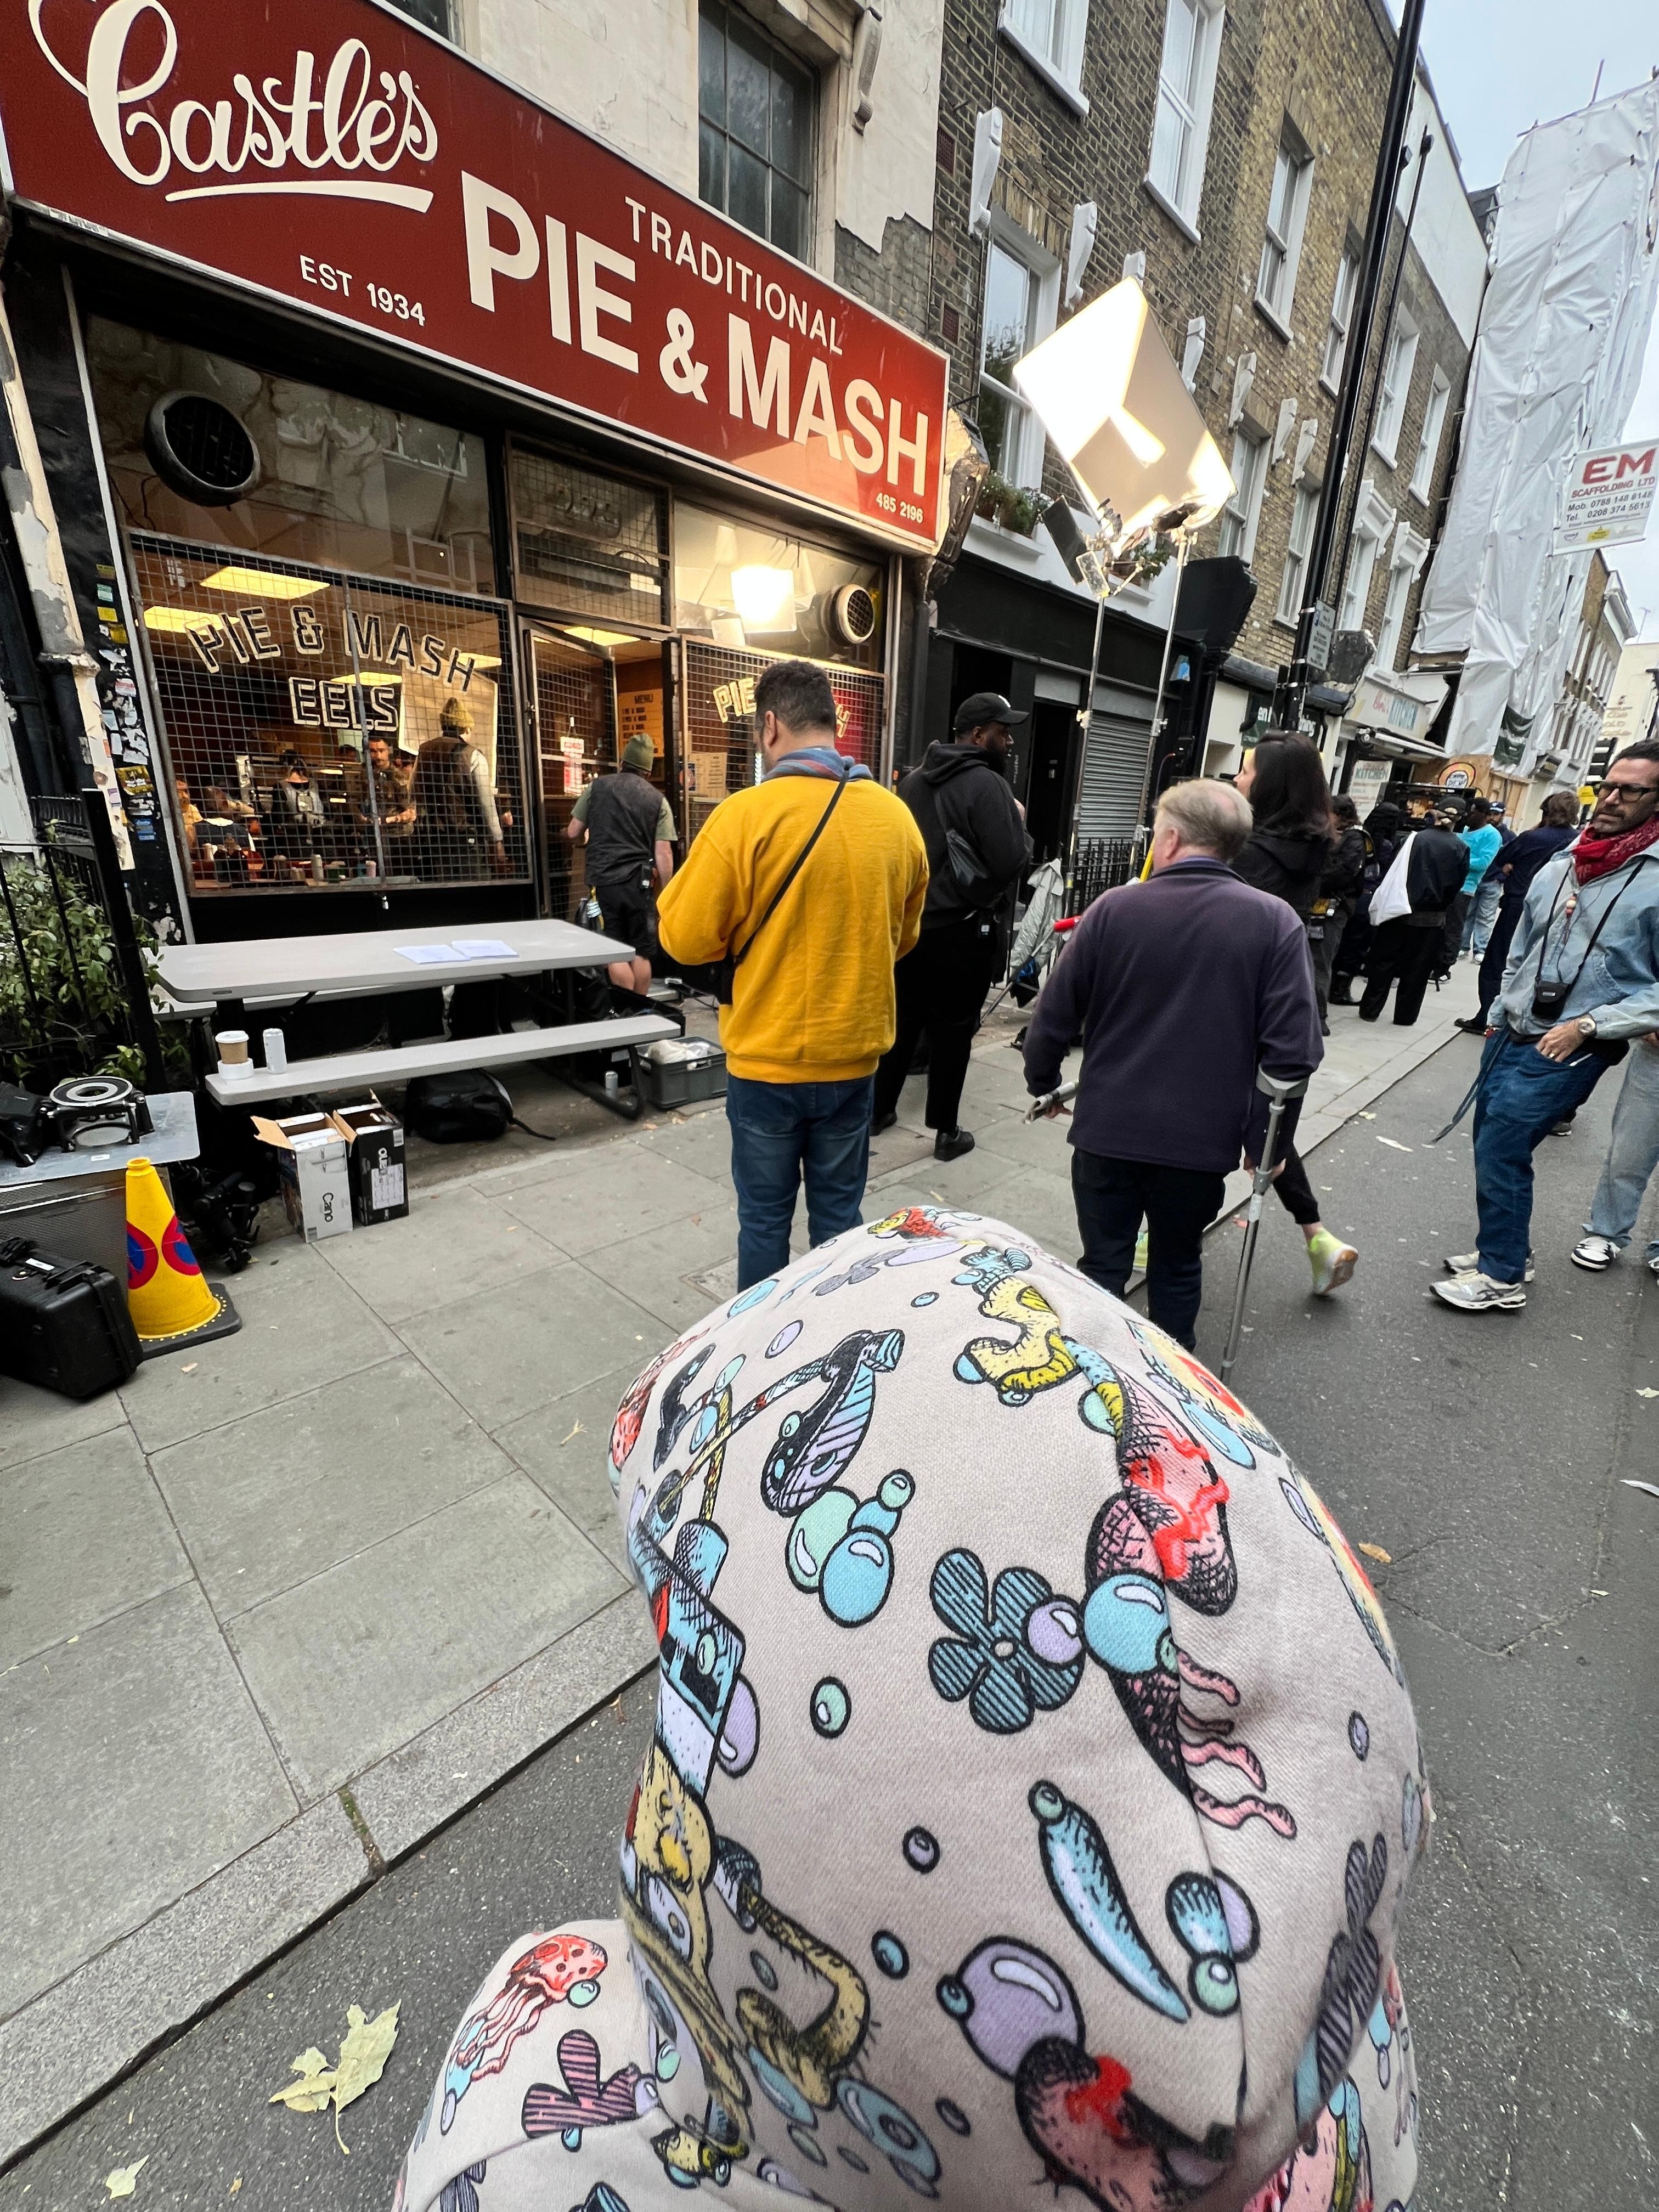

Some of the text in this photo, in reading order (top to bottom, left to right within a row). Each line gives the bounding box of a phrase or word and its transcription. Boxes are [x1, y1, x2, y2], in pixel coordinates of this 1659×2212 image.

[28, 0, 438, 186] Castle's
[300, 254, 426, 326] EST 1934
[625, 196, 843, 356] TRADITIONAL
[461, 170, 928, 497] PIE & MASH
[1571, 476, 1655, 498] SCAFFOLDING LTD
[1583, 447, 1657, 484] EM
[876, 492, 924, 523] 485 2196
[1587, 509, 1607, 518] 0208
[1610, 505, 1626, 515] 374
[1591, 498, 1611, 508] 0788
[1615, 494, 1629, 504] 148
[184, 605, 476, 695] PIE & MASH
[289, 676, 399, 732] EELS
[713, 677, 757, 724] PIE
